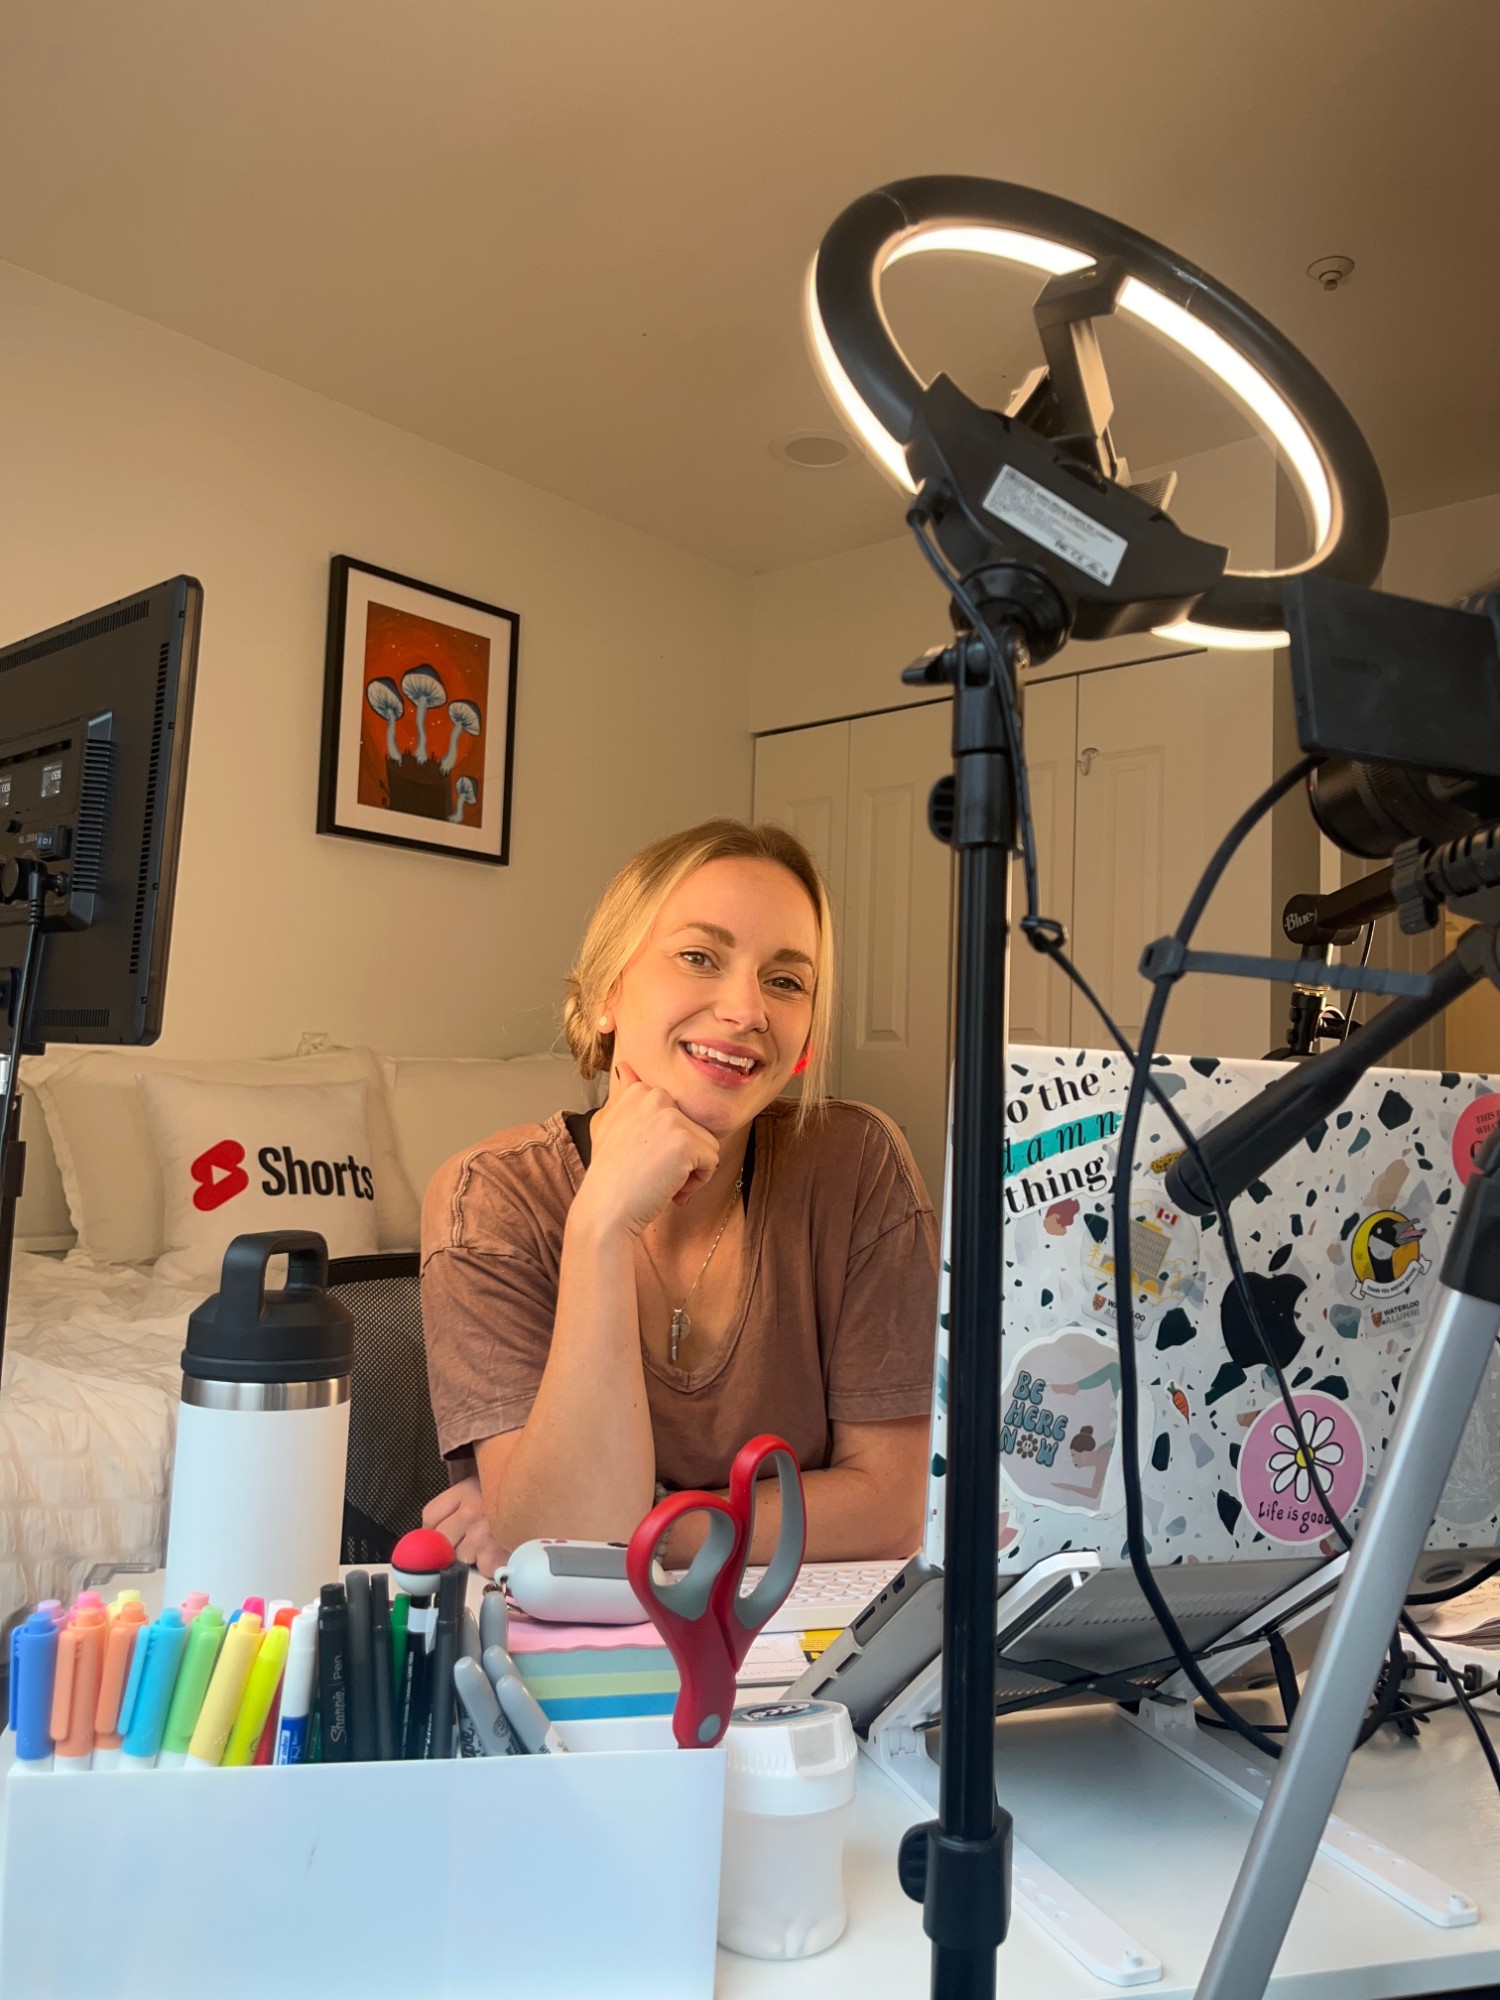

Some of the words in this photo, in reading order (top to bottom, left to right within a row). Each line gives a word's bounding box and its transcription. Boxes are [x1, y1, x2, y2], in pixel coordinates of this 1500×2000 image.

[1285, 911, 1315, 932] Blue
[1005, 1100, 1028, 1123] o
[1038, 1072, 1100, 1112] the
[1475, 1112, 1495, 1123] THIS
[1476, 1122, 1498, 1134] WHA
[258, 1146, 375, 1200] Shorts
[1003, 1156, 1108, 1213] thing
[1383, 1300, 1420, 1316] WATERLOO
[1385, 1307, 1420, 1324] ALUMNI
[1013, 1371, 1046, 1405] BE
[1004, 1400, 1069, 1442] HERE
[1258, 1500, 1284, 1521] Life
[1287, 1506, 1298, 1521] is
